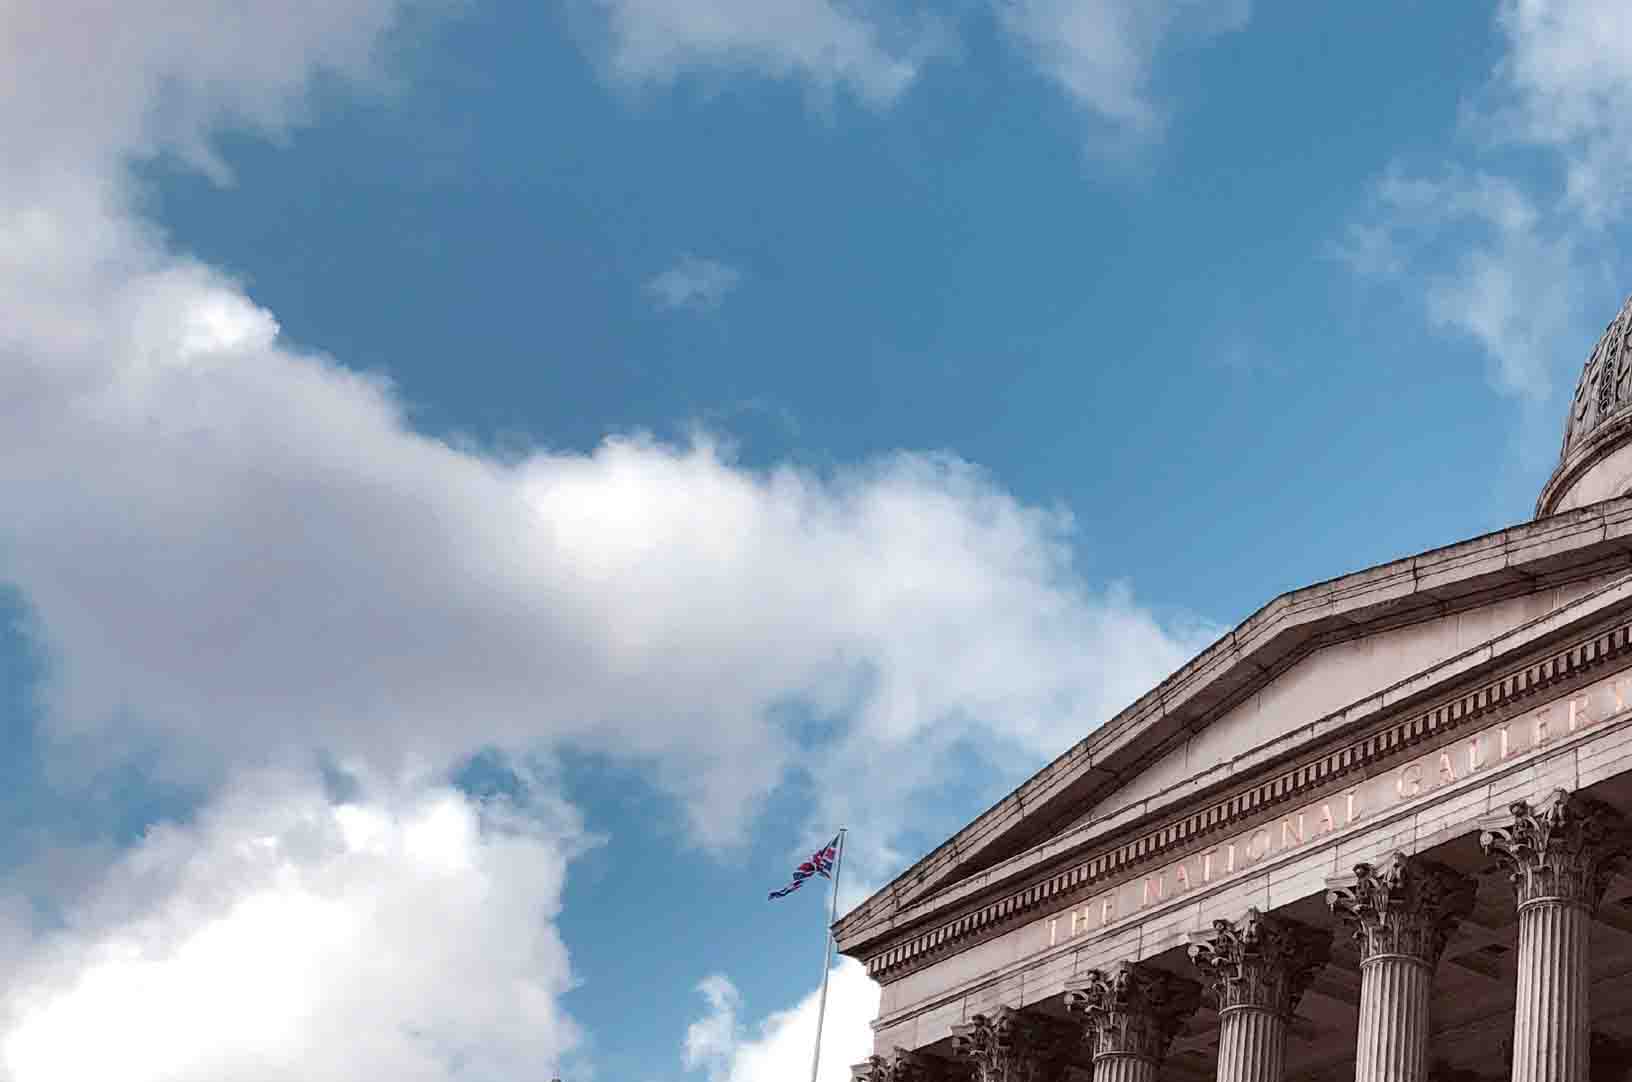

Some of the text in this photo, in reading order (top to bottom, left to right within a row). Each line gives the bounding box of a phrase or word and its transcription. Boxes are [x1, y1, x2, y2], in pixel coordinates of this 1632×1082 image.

[1045, 680, 1632, 947] THE NATIONAL GALLERY
